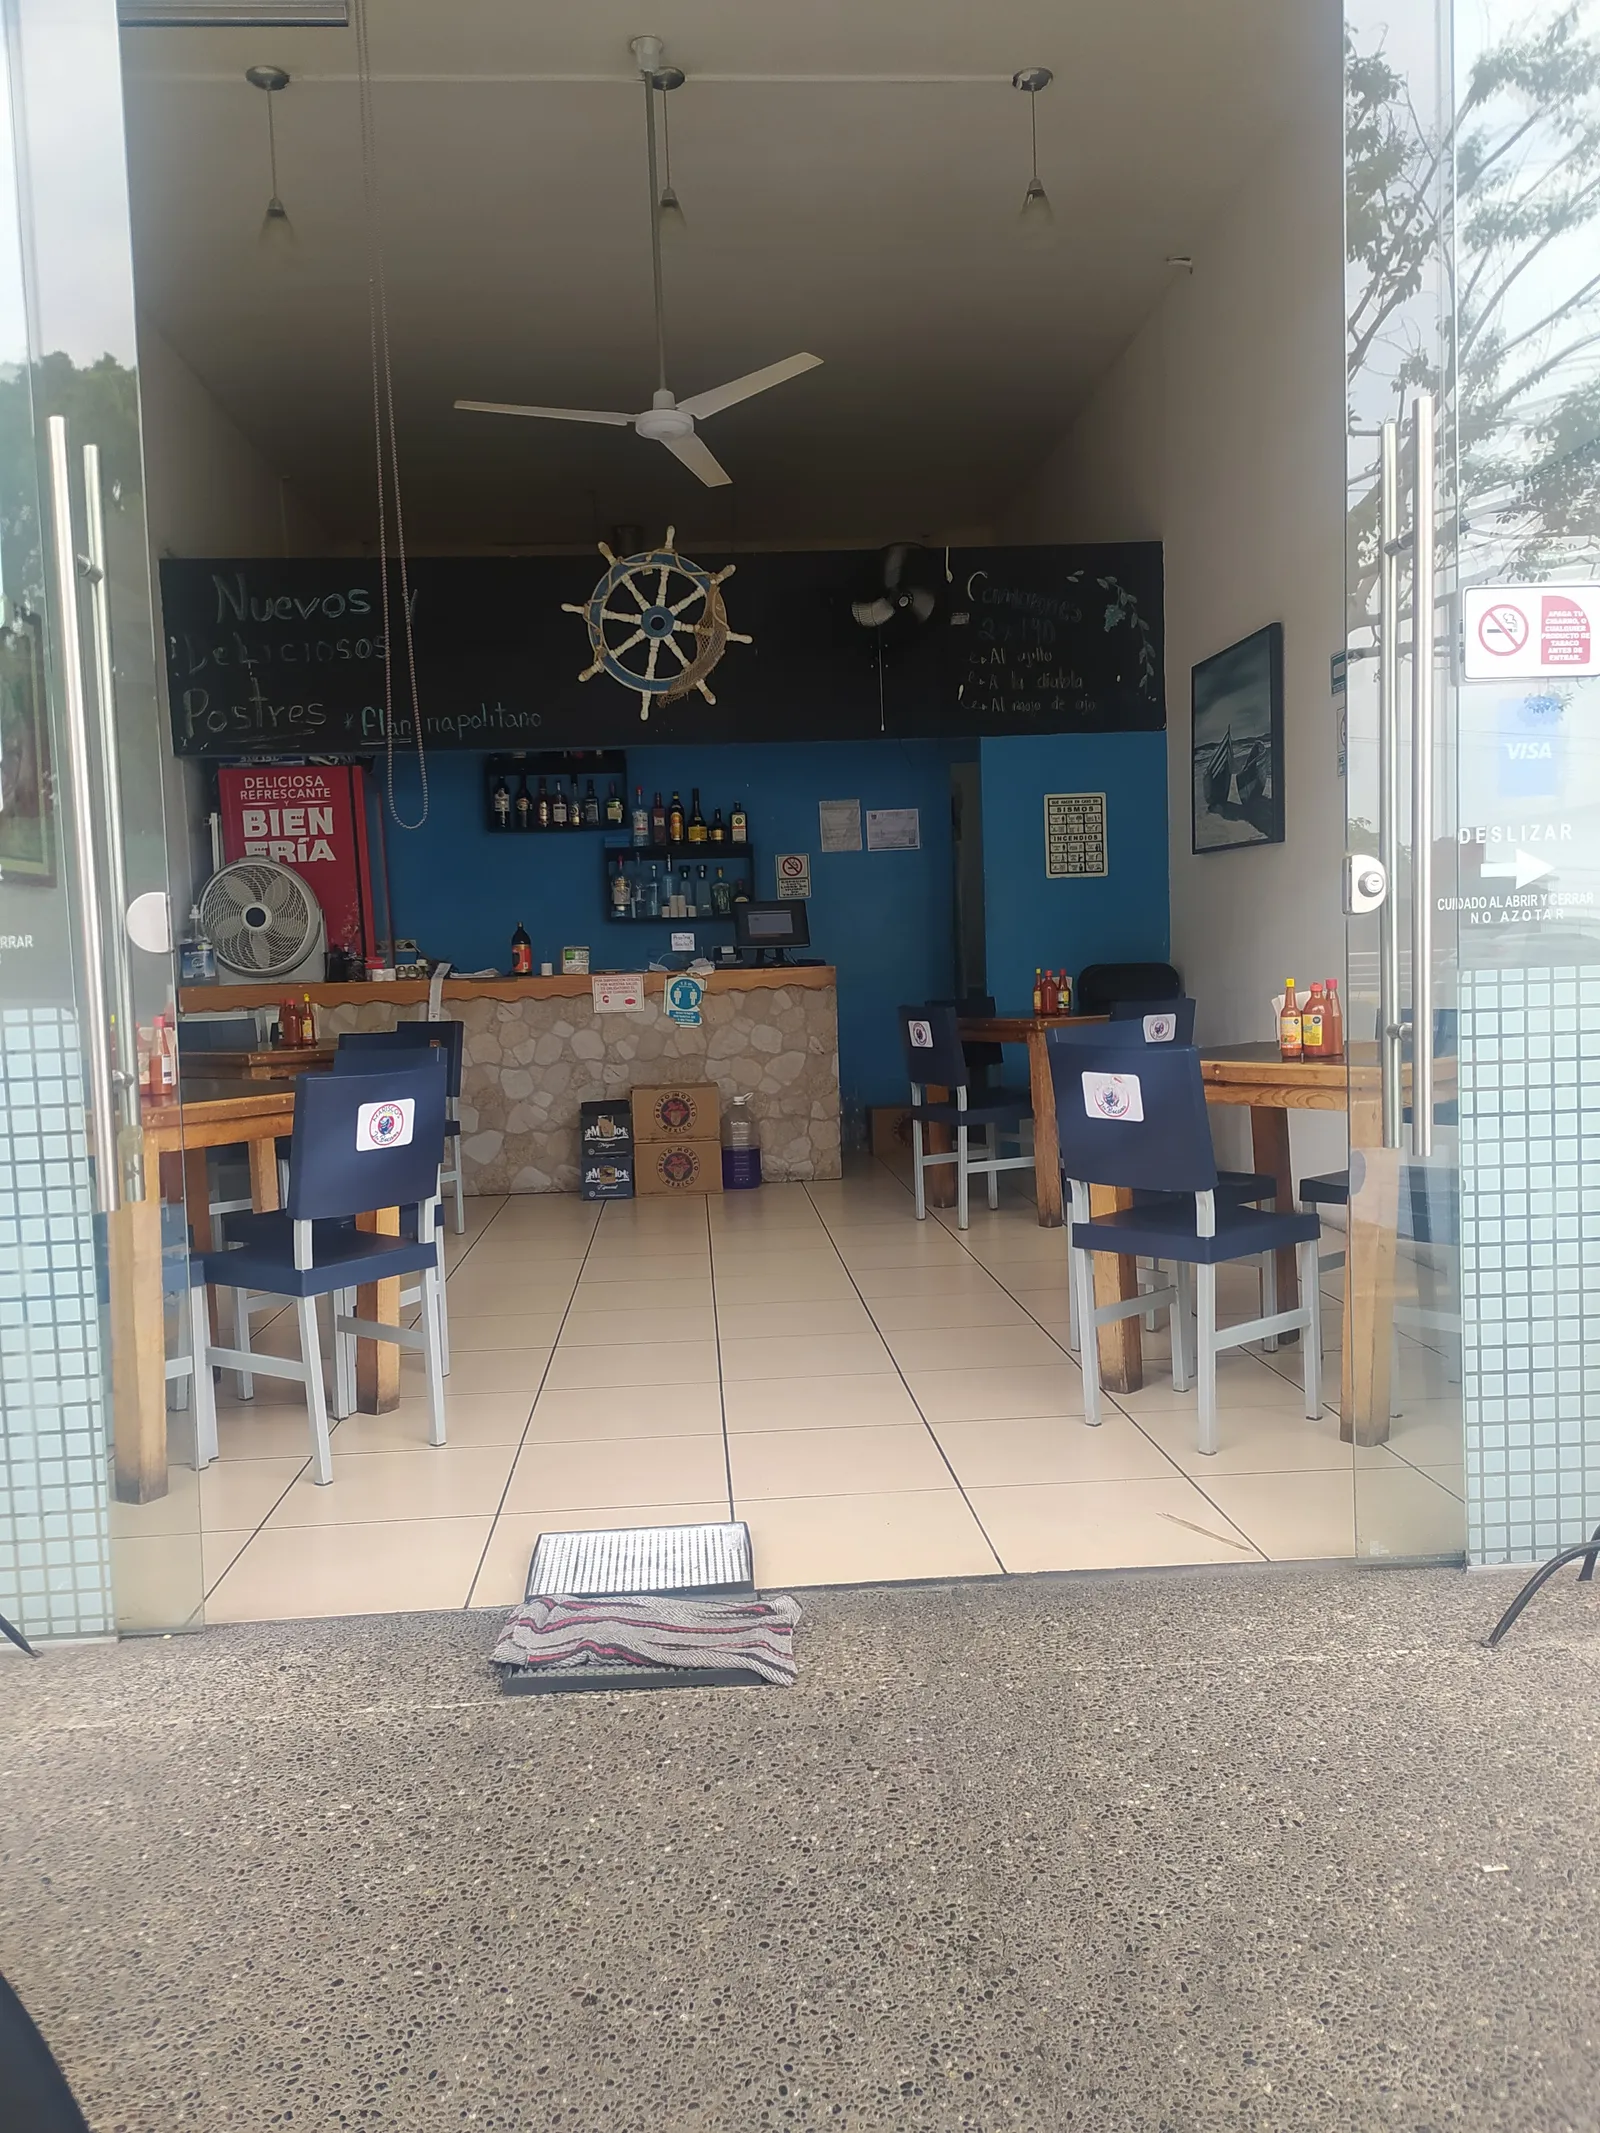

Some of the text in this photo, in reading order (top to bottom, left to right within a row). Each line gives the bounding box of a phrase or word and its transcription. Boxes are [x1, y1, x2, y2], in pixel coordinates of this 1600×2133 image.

[211, 572, 372, 624] Nuevos
[182, 678, 327, 738] Postres
[426, 702, 542, 740] napolitano
[1504, 742, 1552, 760] VISA
[244, 776, 325, 790] DELICIOSA
[240, 788, 332, 800] REFRESCANTE
[242, 807, 334, 838] BIEN
[1458, 823, 1572, 845] DESLIZAR
[1438, 892, 1594, 911] CUIDADO AL ABRIR Y CERRAR
[1470, 908, 1564, 924] NO AZOTAR
